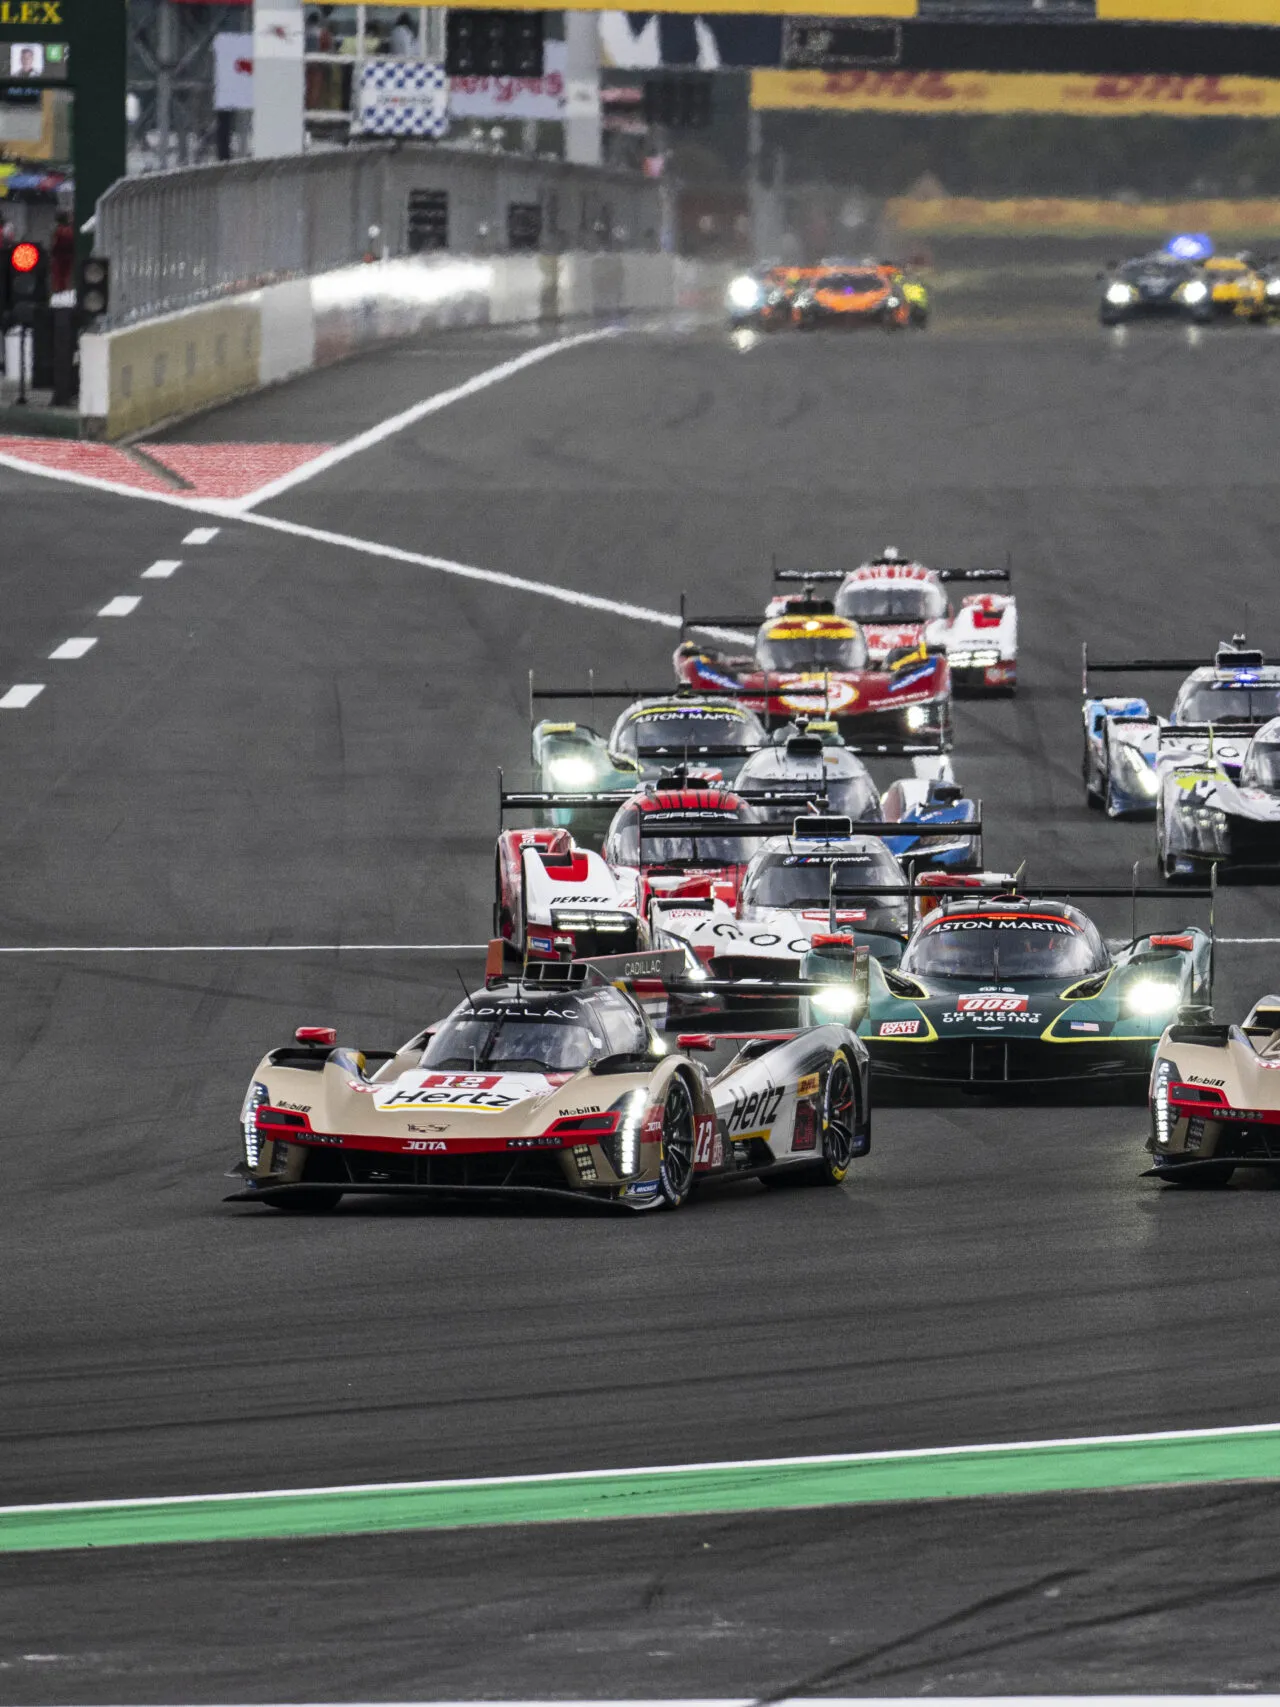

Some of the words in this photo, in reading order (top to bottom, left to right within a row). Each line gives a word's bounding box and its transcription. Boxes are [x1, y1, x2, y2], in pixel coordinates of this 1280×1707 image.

[643, 811, 739, 820] PORSCHE
[930, 921, 993, 934] ASTON
[999, 921, 1075, 935] MARTIN
[625, 960, 661, 976] CADILLAC
[963, 999, 1022, 1010] 009
[453, 1008, 579, 1019] CADILLAC
[882, 1026, 915, 1034] CAR
[384, 1089, 521, 1107] Hertz
[726, 1080, 785, 1132] Hertz
[402, 1141, 447, 1151] JOTA
[695, 1121, 713, 1163] 12
